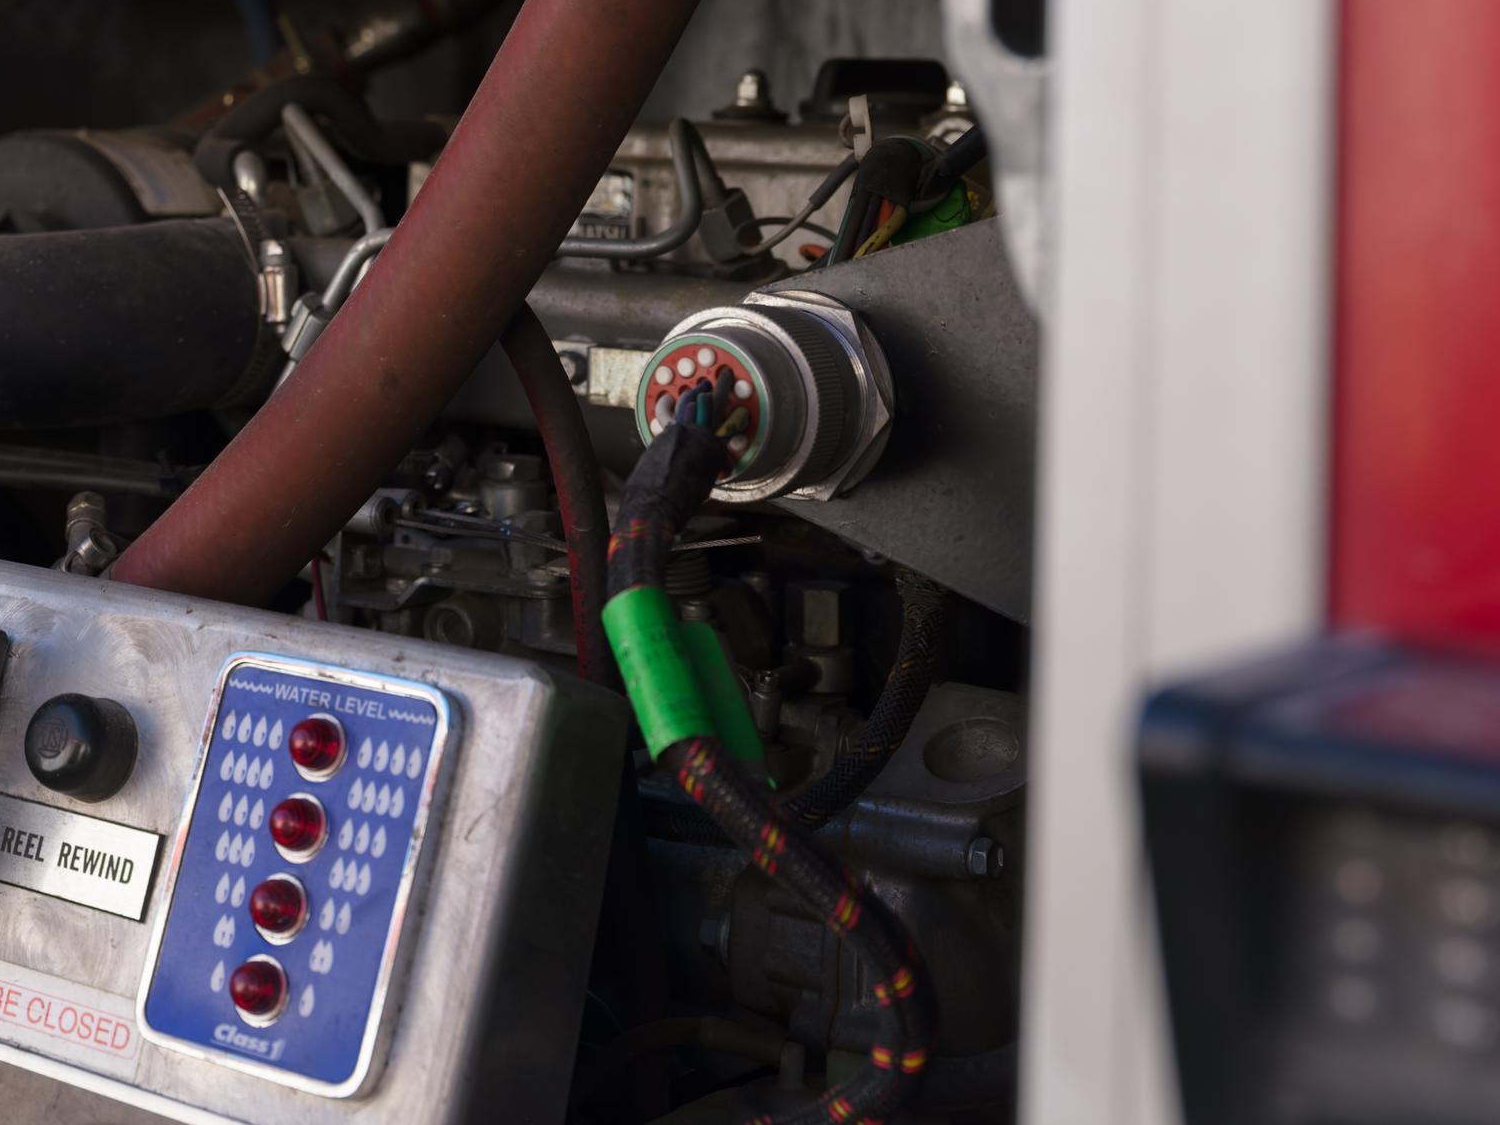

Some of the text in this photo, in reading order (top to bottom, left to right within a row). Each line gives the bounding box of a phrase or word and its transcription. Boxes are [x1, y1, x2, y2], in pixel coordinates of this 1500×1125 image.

[274, 682, 388, 721] WATER LEVEL
[37, 726, 69, 751] USH
[0, 826, 135, 886] REEL REWIND
[25, 998, 132, 1052] CLOSED
